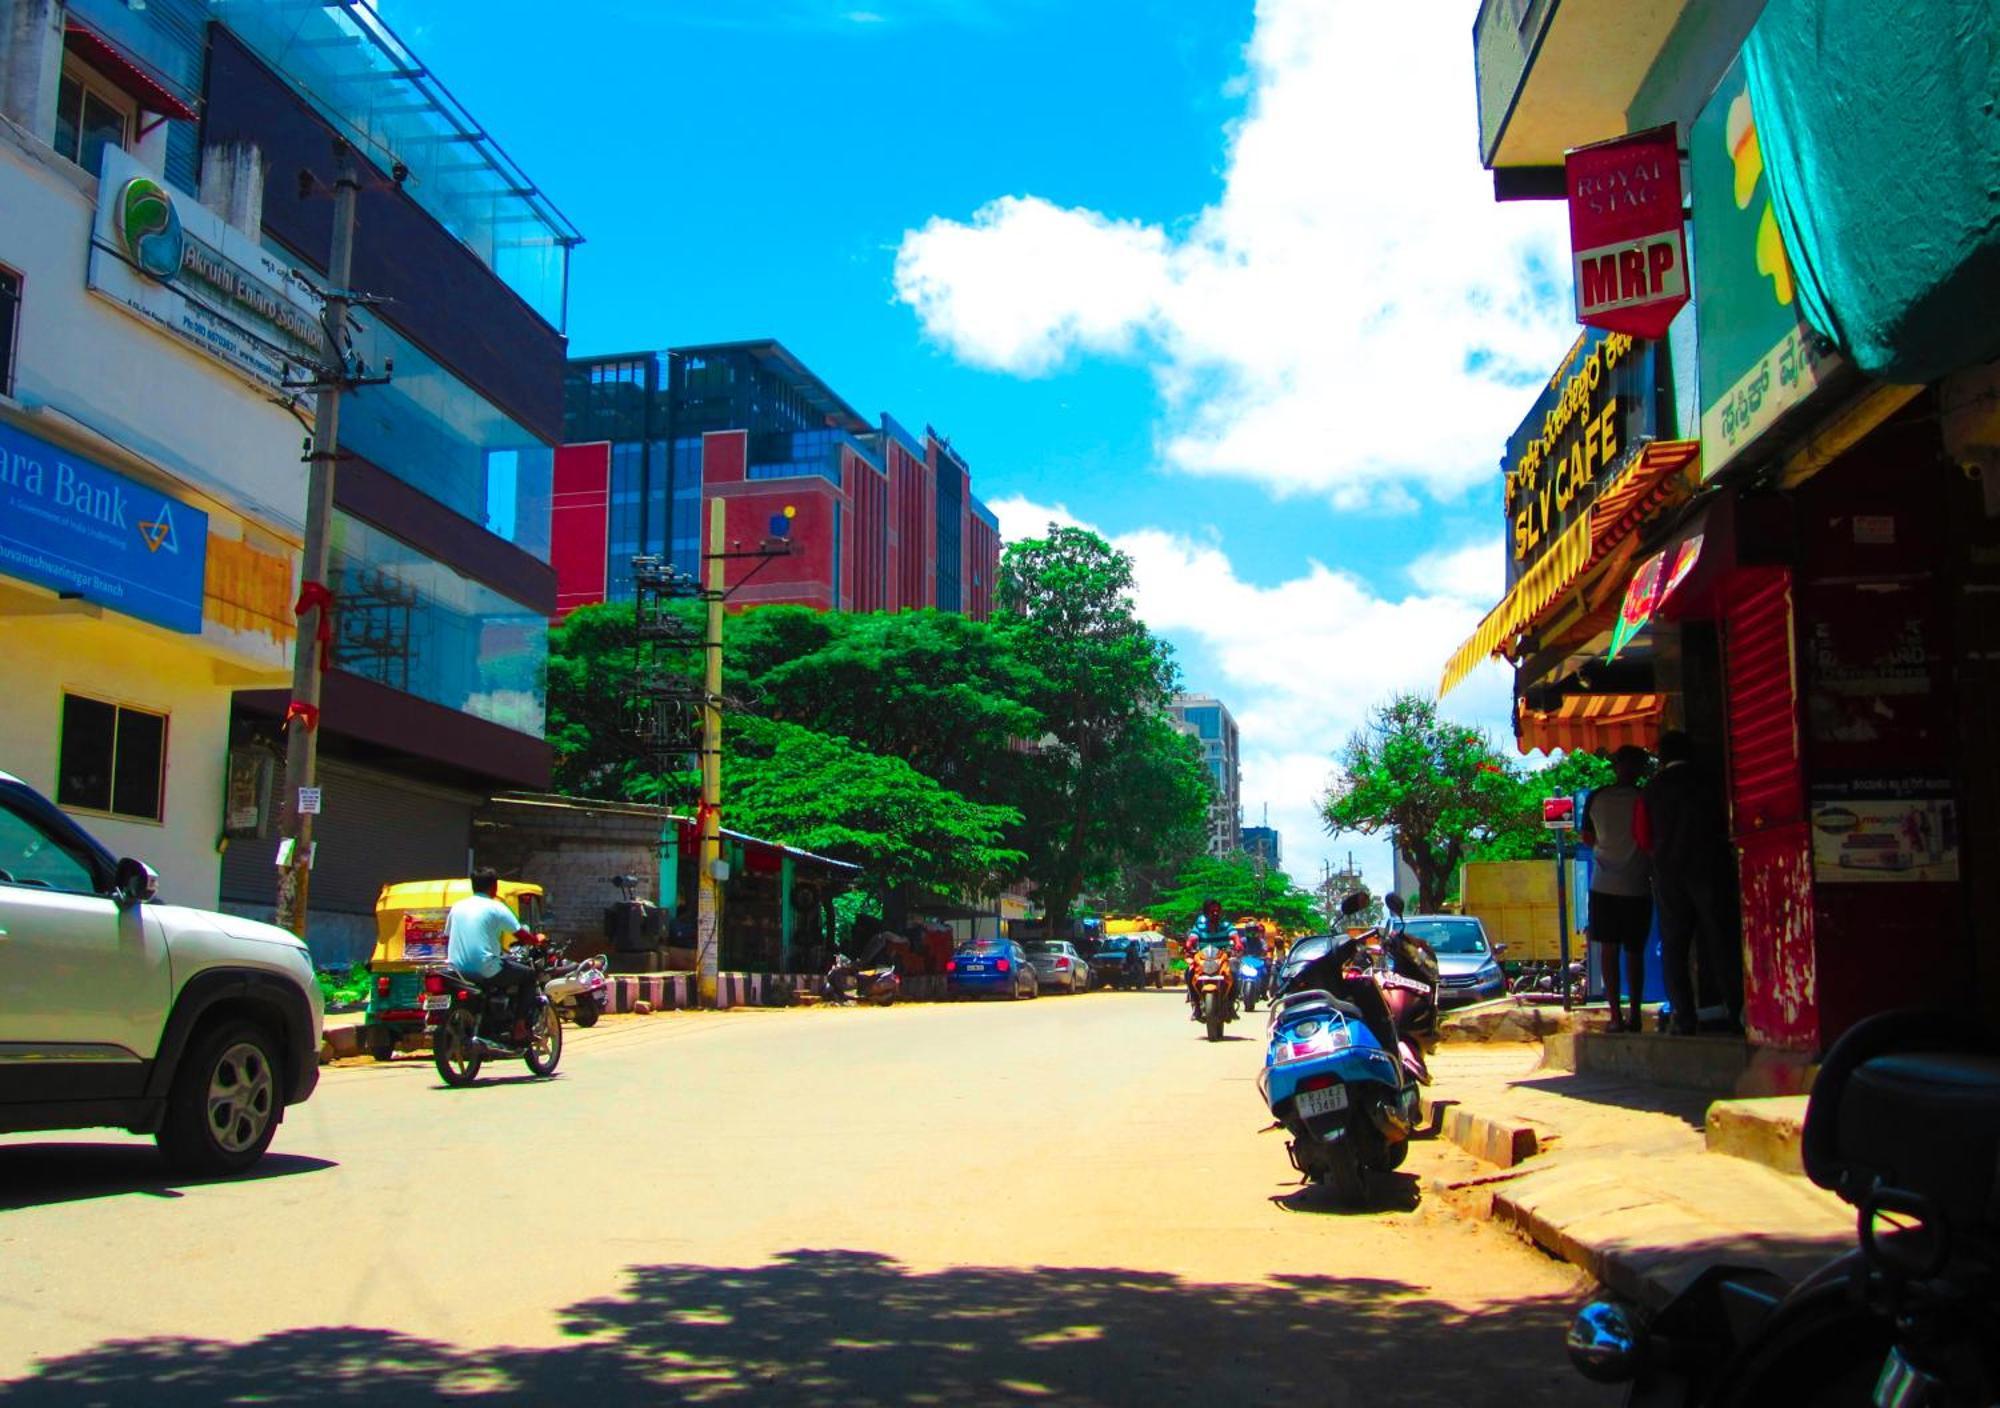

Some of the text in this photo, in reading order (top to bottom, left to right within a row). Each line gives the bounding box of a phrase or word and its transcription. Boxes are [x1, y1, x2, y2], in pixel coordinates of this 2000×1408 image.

[237, 277, 277, 317] Enviro
[1581, 243, 1675, 308] MRP
[1556, 398, 1617, 513] CAFE
[54, 461, 128, 530] Bank
[94, 575, 124, 598] Branch
